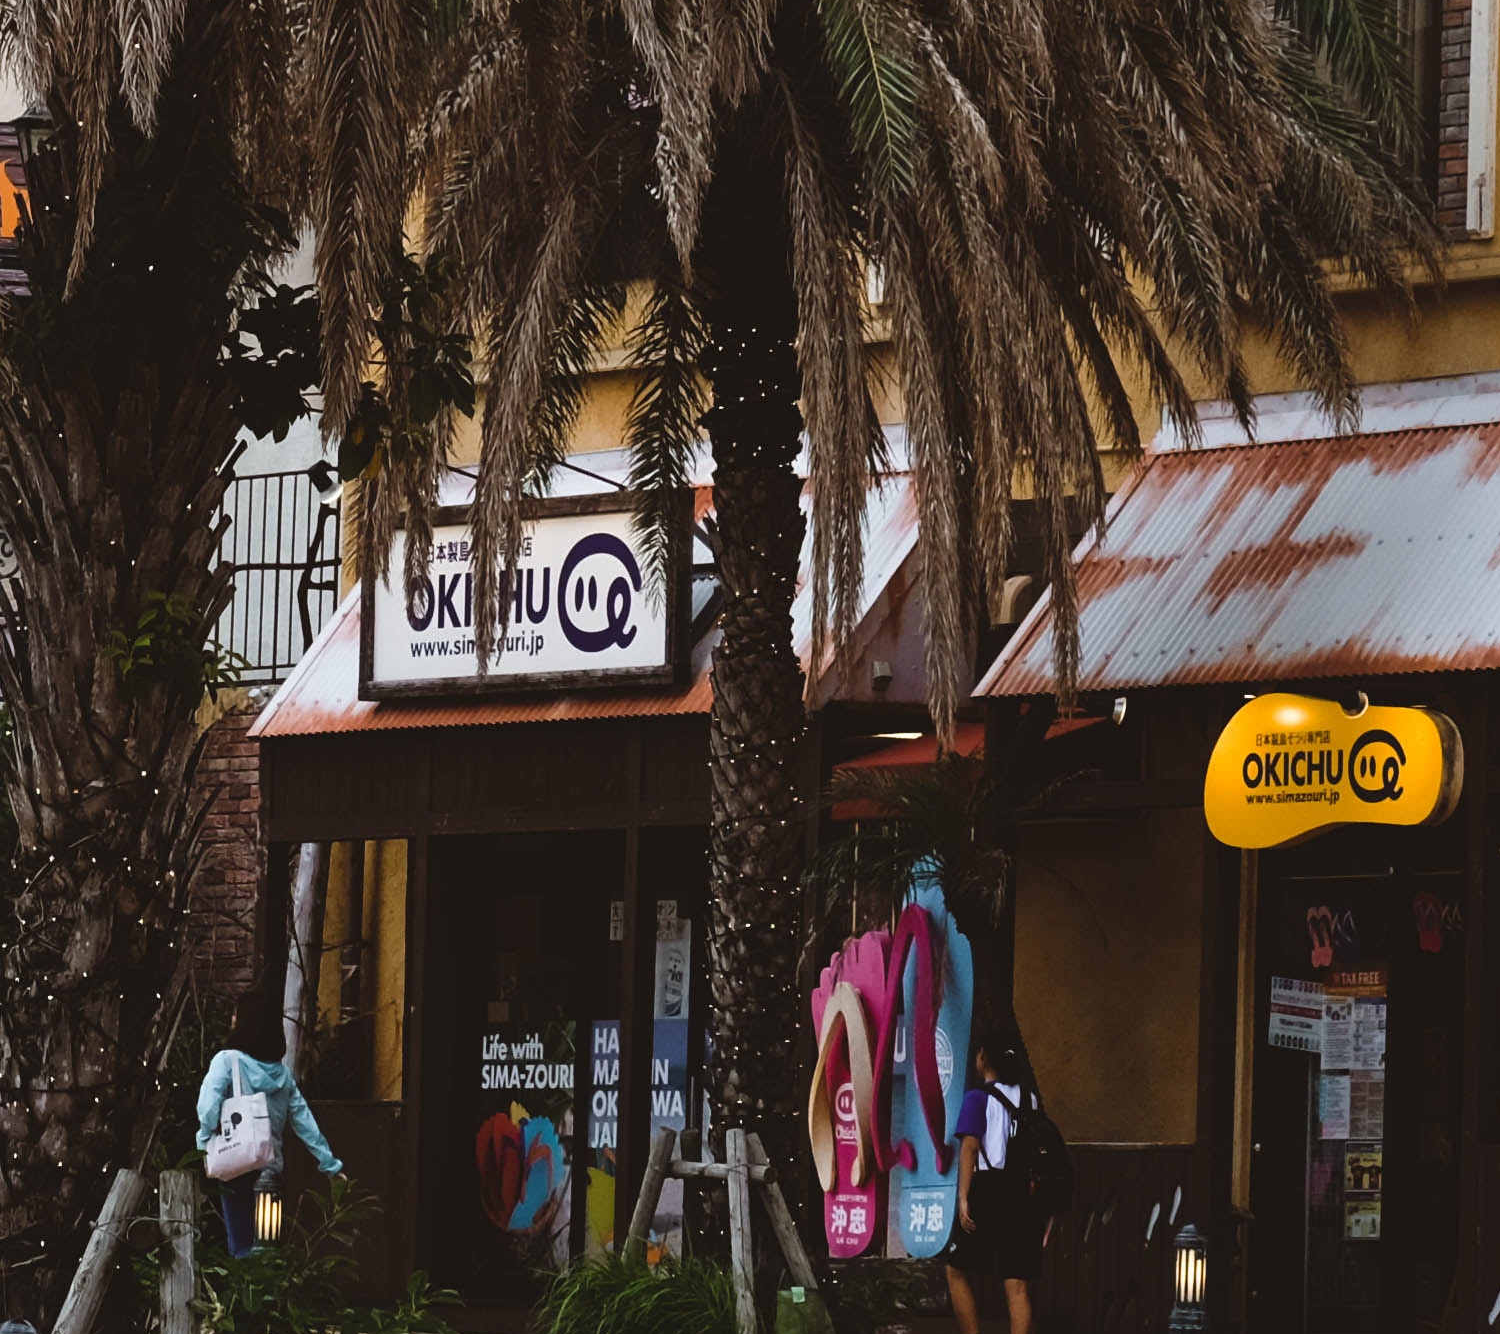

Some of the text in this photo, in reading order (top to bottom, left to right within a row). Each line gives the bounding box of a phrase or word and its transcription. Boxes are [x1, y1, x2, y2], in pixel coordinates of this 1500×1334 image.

[406, 566, 551, 632] OKIHU
[1242, 749, 1344, 789] OKICHU
[1245, 788, 1340, 805] www.simazouri.jp
[483, 1032, 544, 1060] Life with
[481, 1064, 574, 1089] SIMA-ZOURI
